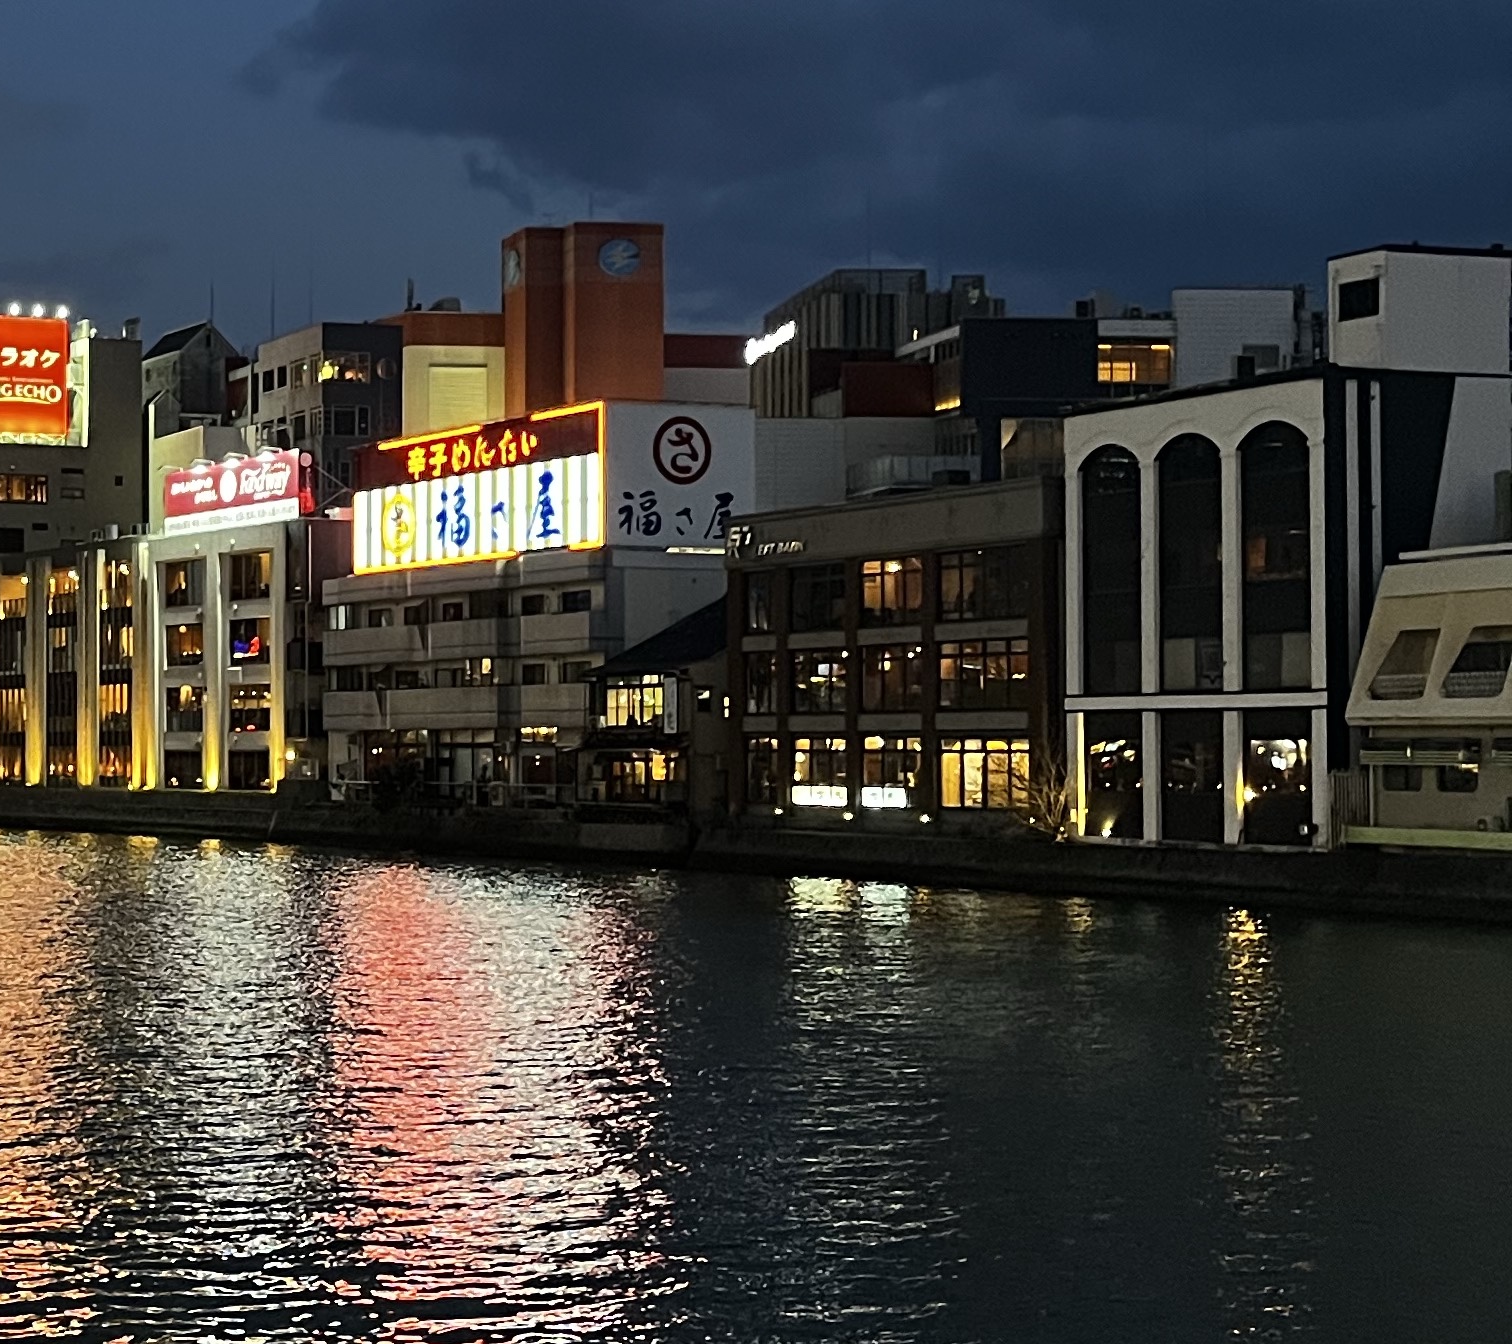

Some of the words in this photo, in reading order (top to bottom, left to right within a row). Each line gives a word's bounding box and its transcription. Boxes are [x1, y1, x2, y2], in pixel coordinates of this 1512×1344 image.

[15, 384, 62, 403] ECHO
[435, 469, 561, 548] 福さ屋
